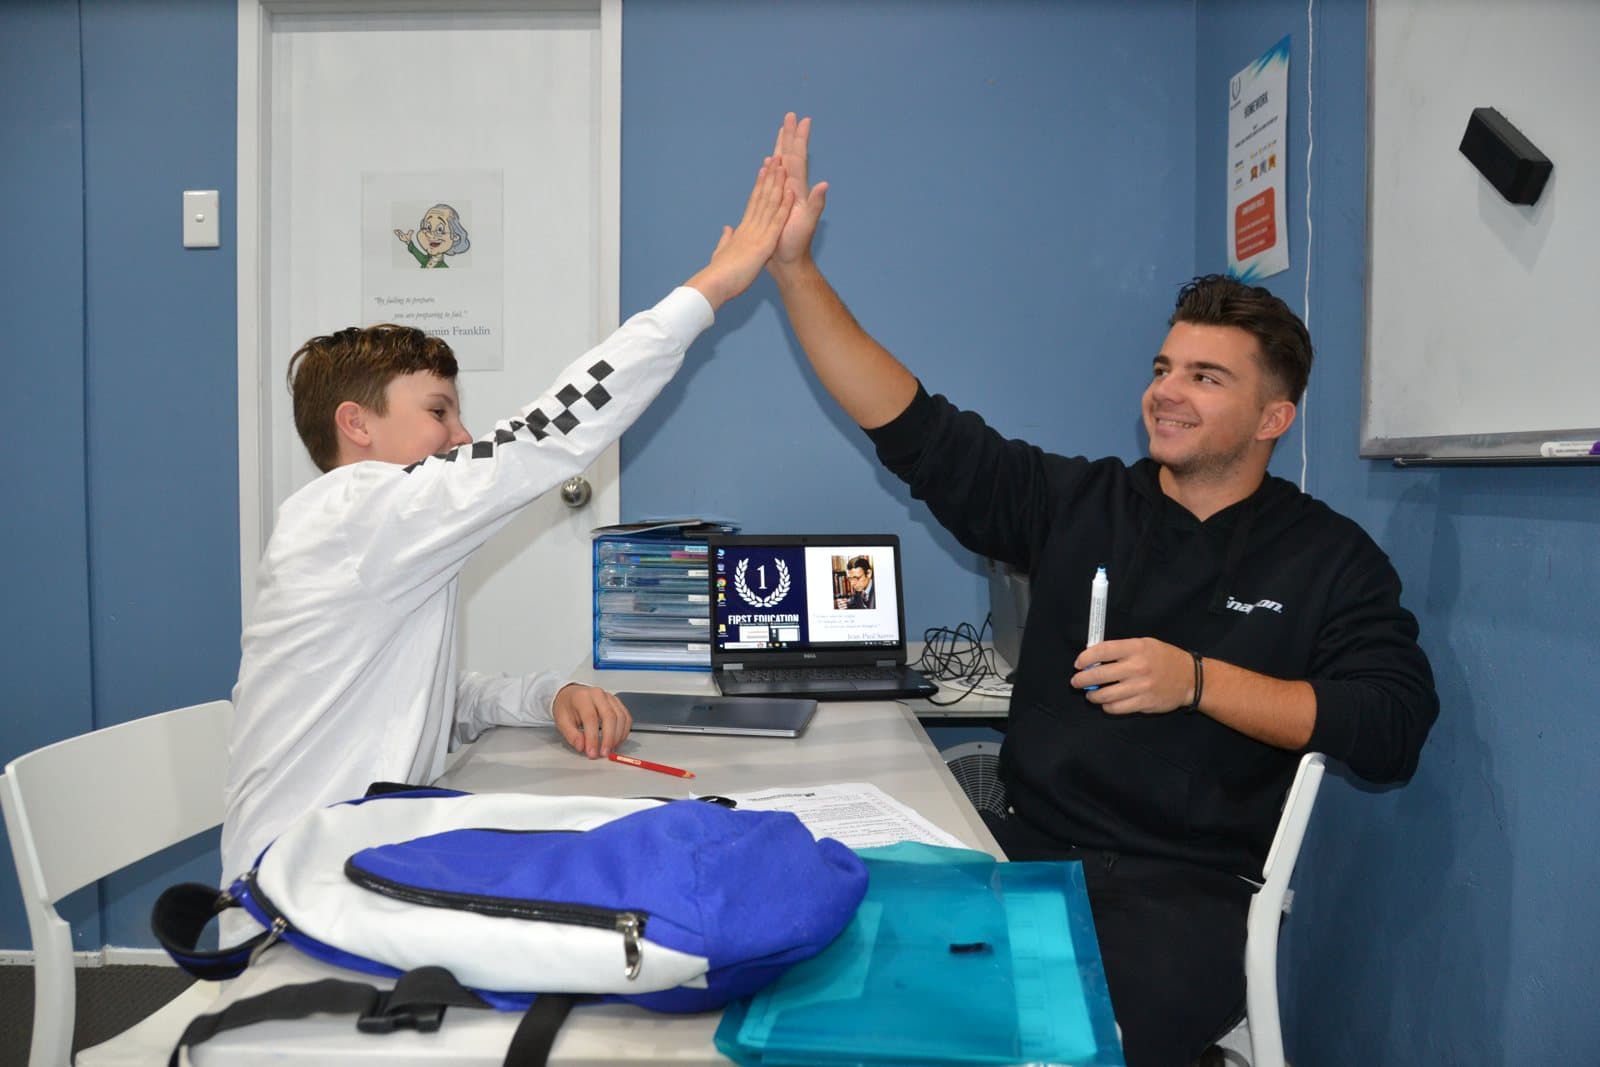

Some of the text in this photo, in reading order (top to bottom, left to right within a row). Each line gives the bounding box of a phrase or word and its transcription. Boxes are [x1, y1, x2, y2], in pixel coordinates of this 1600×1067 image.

[386, 296, 404, 305] failing
[392, 312, 404, 321] you
[415, 312, 443, 320] preparing
[453, 325, 490, 336] Franklin
[756, 565, 768, 590] 1
[728, 614, 799, 625] FIRST EDUCATION
